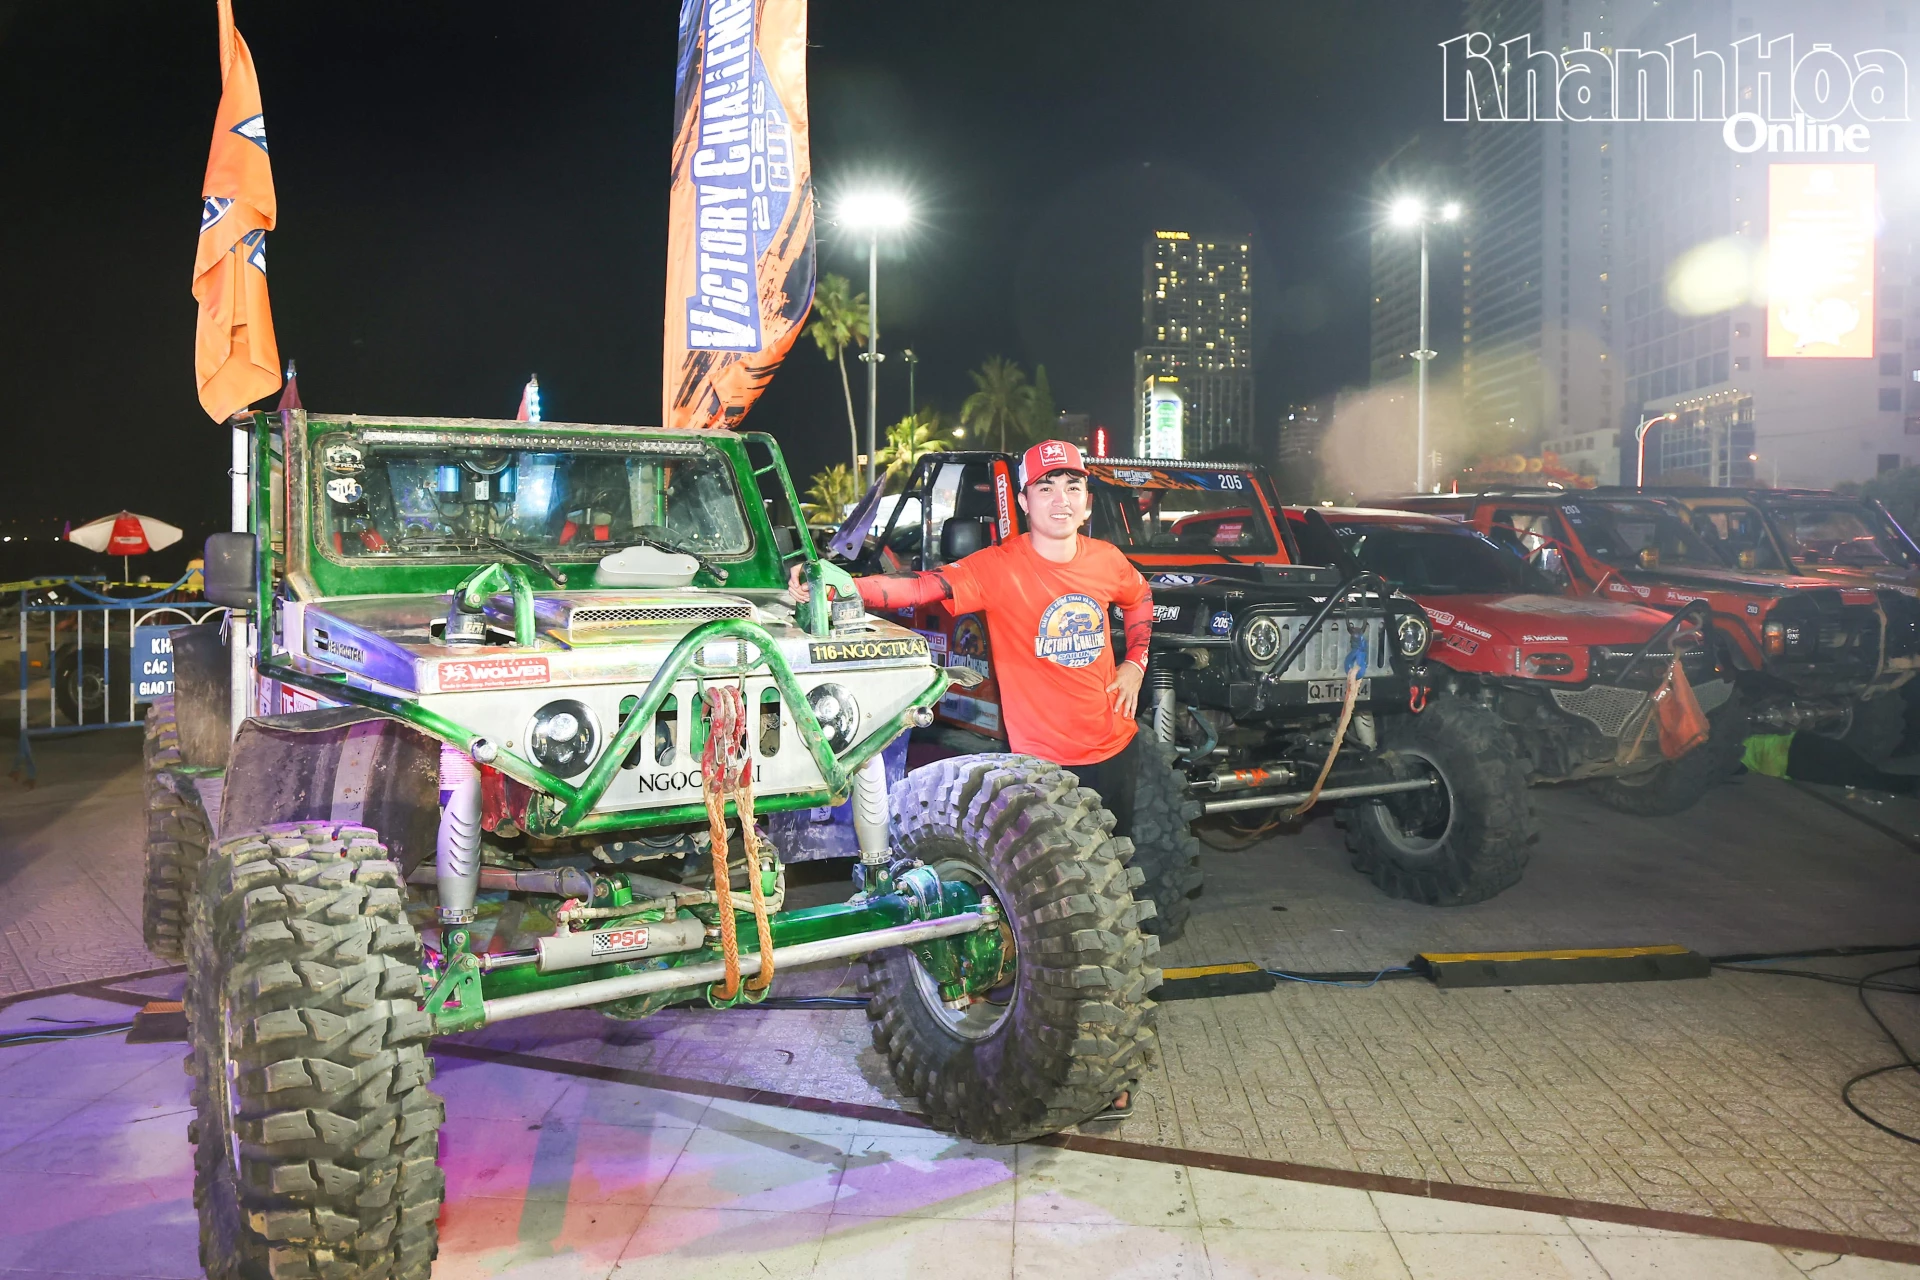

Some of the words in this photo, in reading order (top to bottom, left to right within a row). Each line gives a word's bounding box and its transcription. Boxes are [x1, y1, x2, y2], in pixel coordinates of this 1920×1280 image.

[750, 81, 771, 231] 2026
[766, 109, 795, 193] CUP
[690, 184, 757, 348] VICTORY
[1217, 474, 1243, 490] 205
[1561, 504, 1581, 515] 203
[1747, 605, 1758, 614] 203
[1212, 616, 1230, 629] 205
[1464, 623, 1492, 639] WOLVER
[1036, 637, 1072, 657] VICTORY
[143, 658, 168, 675] CÁC
[467, 663, 547, 680] WOLVER
[139, 681, 165, 695] GIAO
[609, 929, 647, 948] PSC
